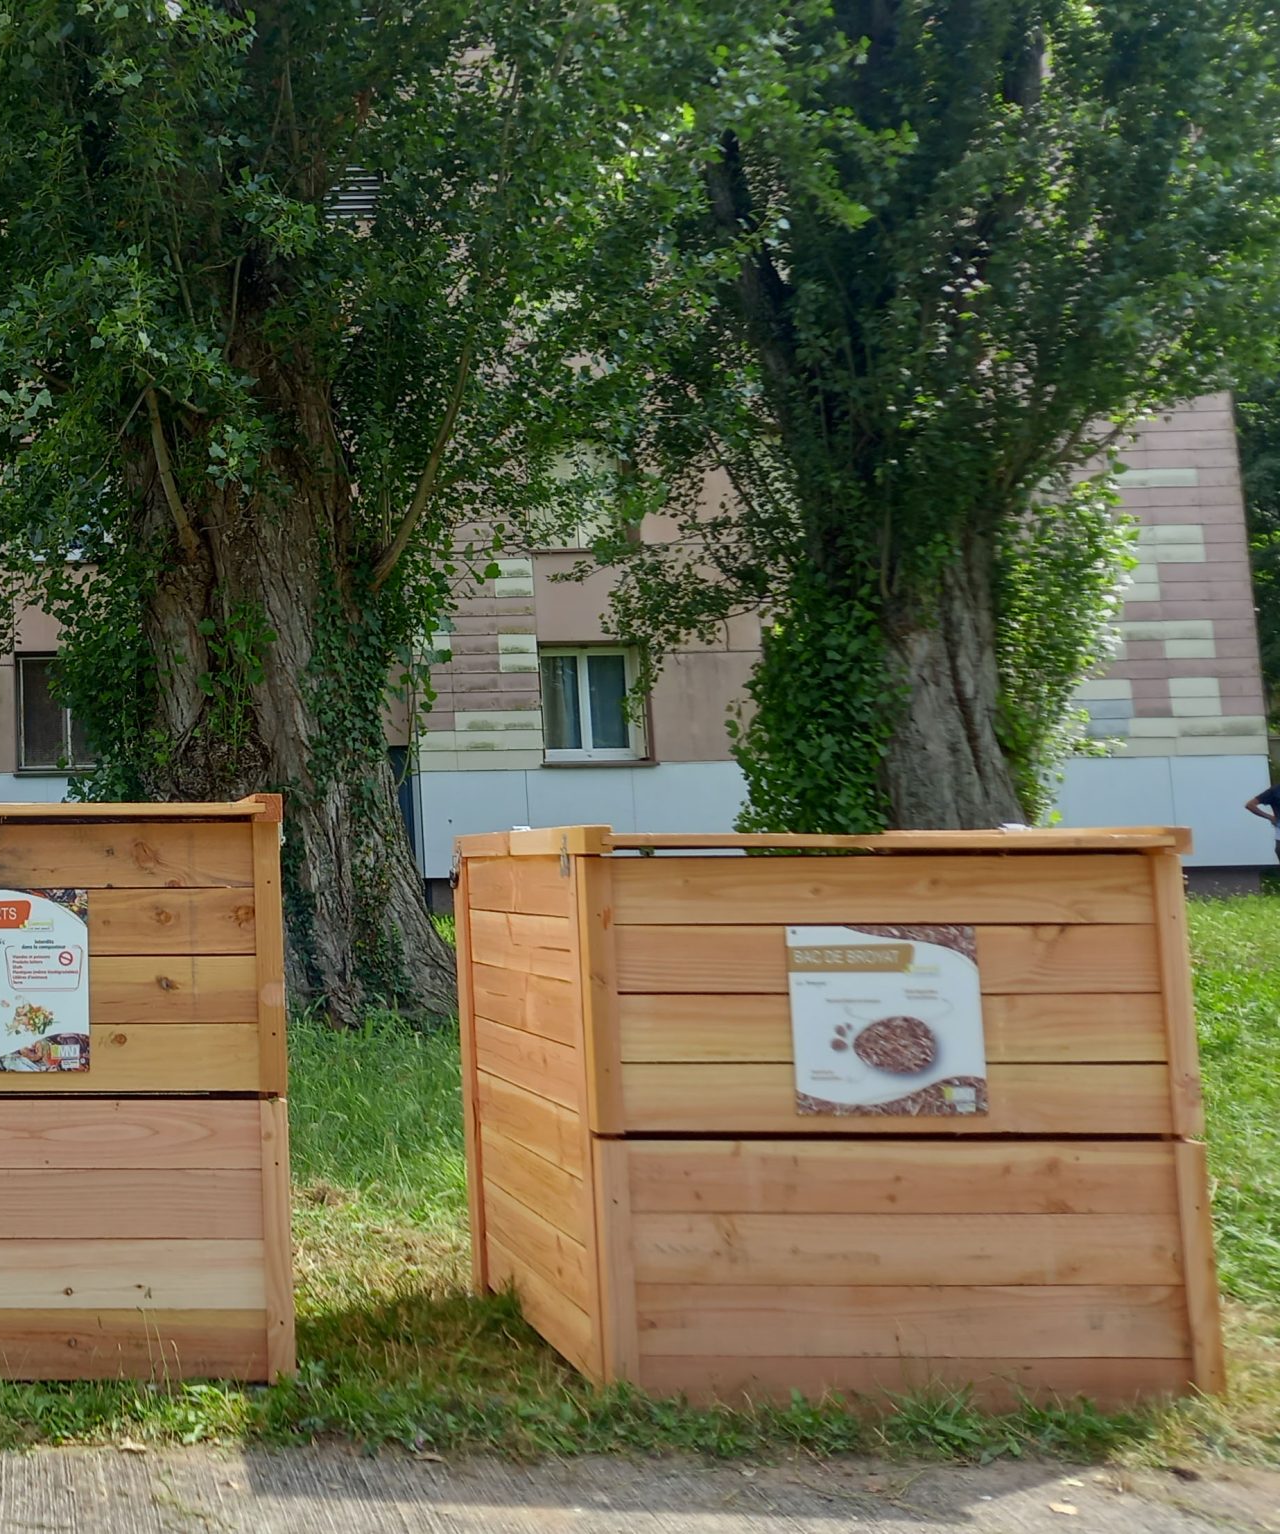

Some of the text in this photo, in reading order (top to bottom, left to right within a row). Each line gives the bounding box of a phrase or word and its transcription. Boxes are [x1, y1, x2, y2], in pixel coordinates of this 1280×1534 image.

[794, 949, 900, 964] BAC DE BROYAT
